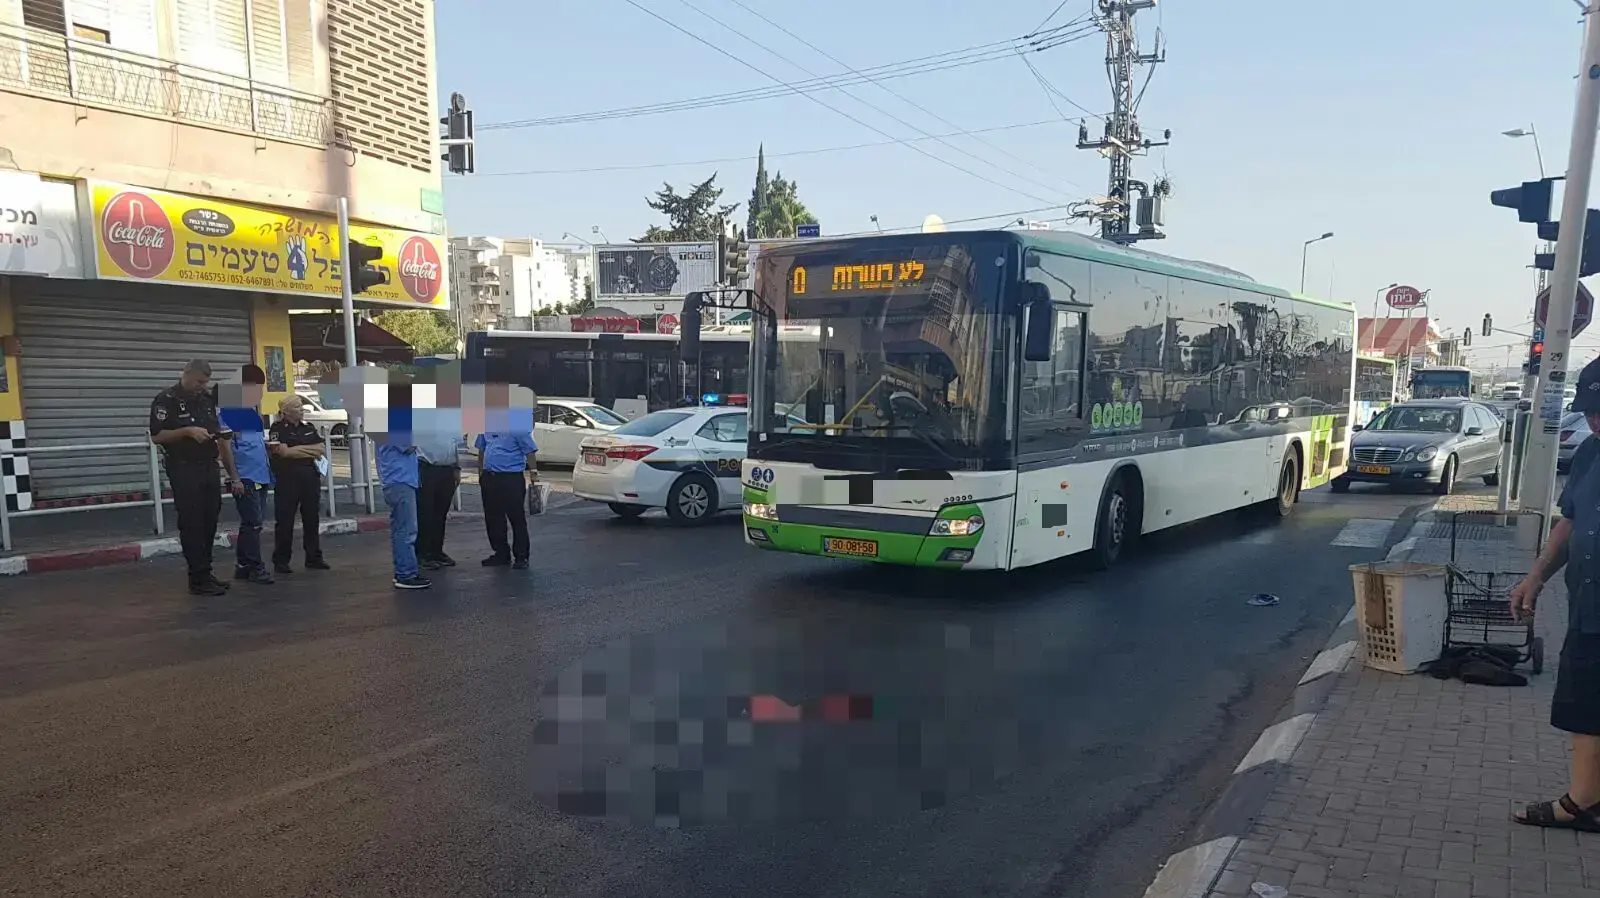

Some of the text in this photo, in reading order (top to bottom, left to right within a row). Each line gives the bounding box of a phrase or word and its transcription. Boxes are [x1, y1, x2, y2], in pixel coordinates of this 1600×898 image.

[198, 209, 218, 220] כשר
[108, 220, 167, 249] Coca-Cola
[186, 241, 280, 274] טעמים
[179, 269, 226, 282] 052-7465753
[1390, 293, 1413, 307] ביתן
[1550, 352, 1563, 361] 29
